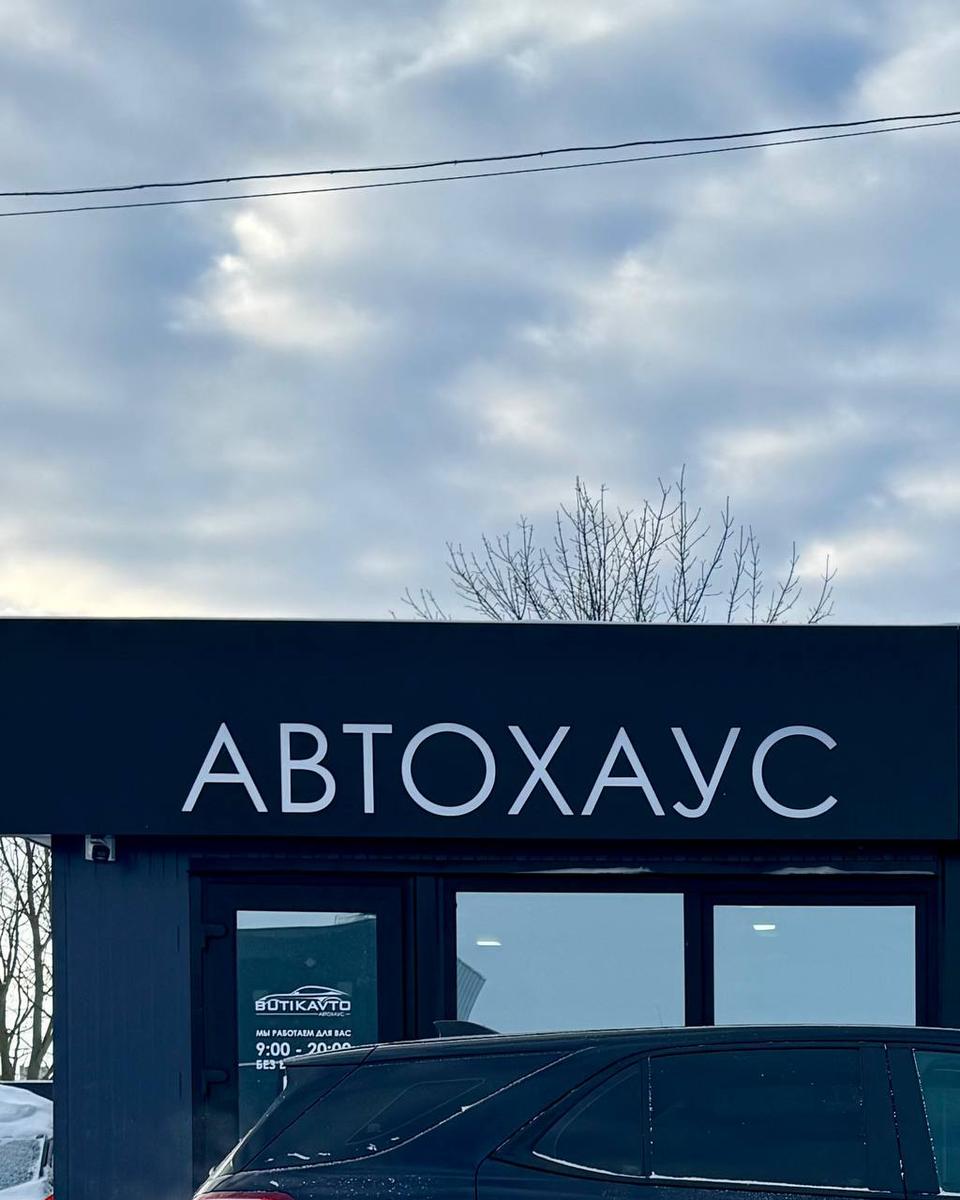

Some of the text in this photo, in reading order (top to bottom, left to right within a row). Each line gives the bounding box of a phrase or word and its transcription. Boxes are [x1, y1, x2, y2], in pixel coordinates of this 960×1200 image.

[182, 722, 838, 819] АВТОХАУС
[255, 1000, 351, 1012] BUTIKAVTO
[315, 1030, 333, 1038] ДЛЯ
[255, 1042, 291, 1057] 9:00
[255, 1060, 276, 1070] БЕЗ
